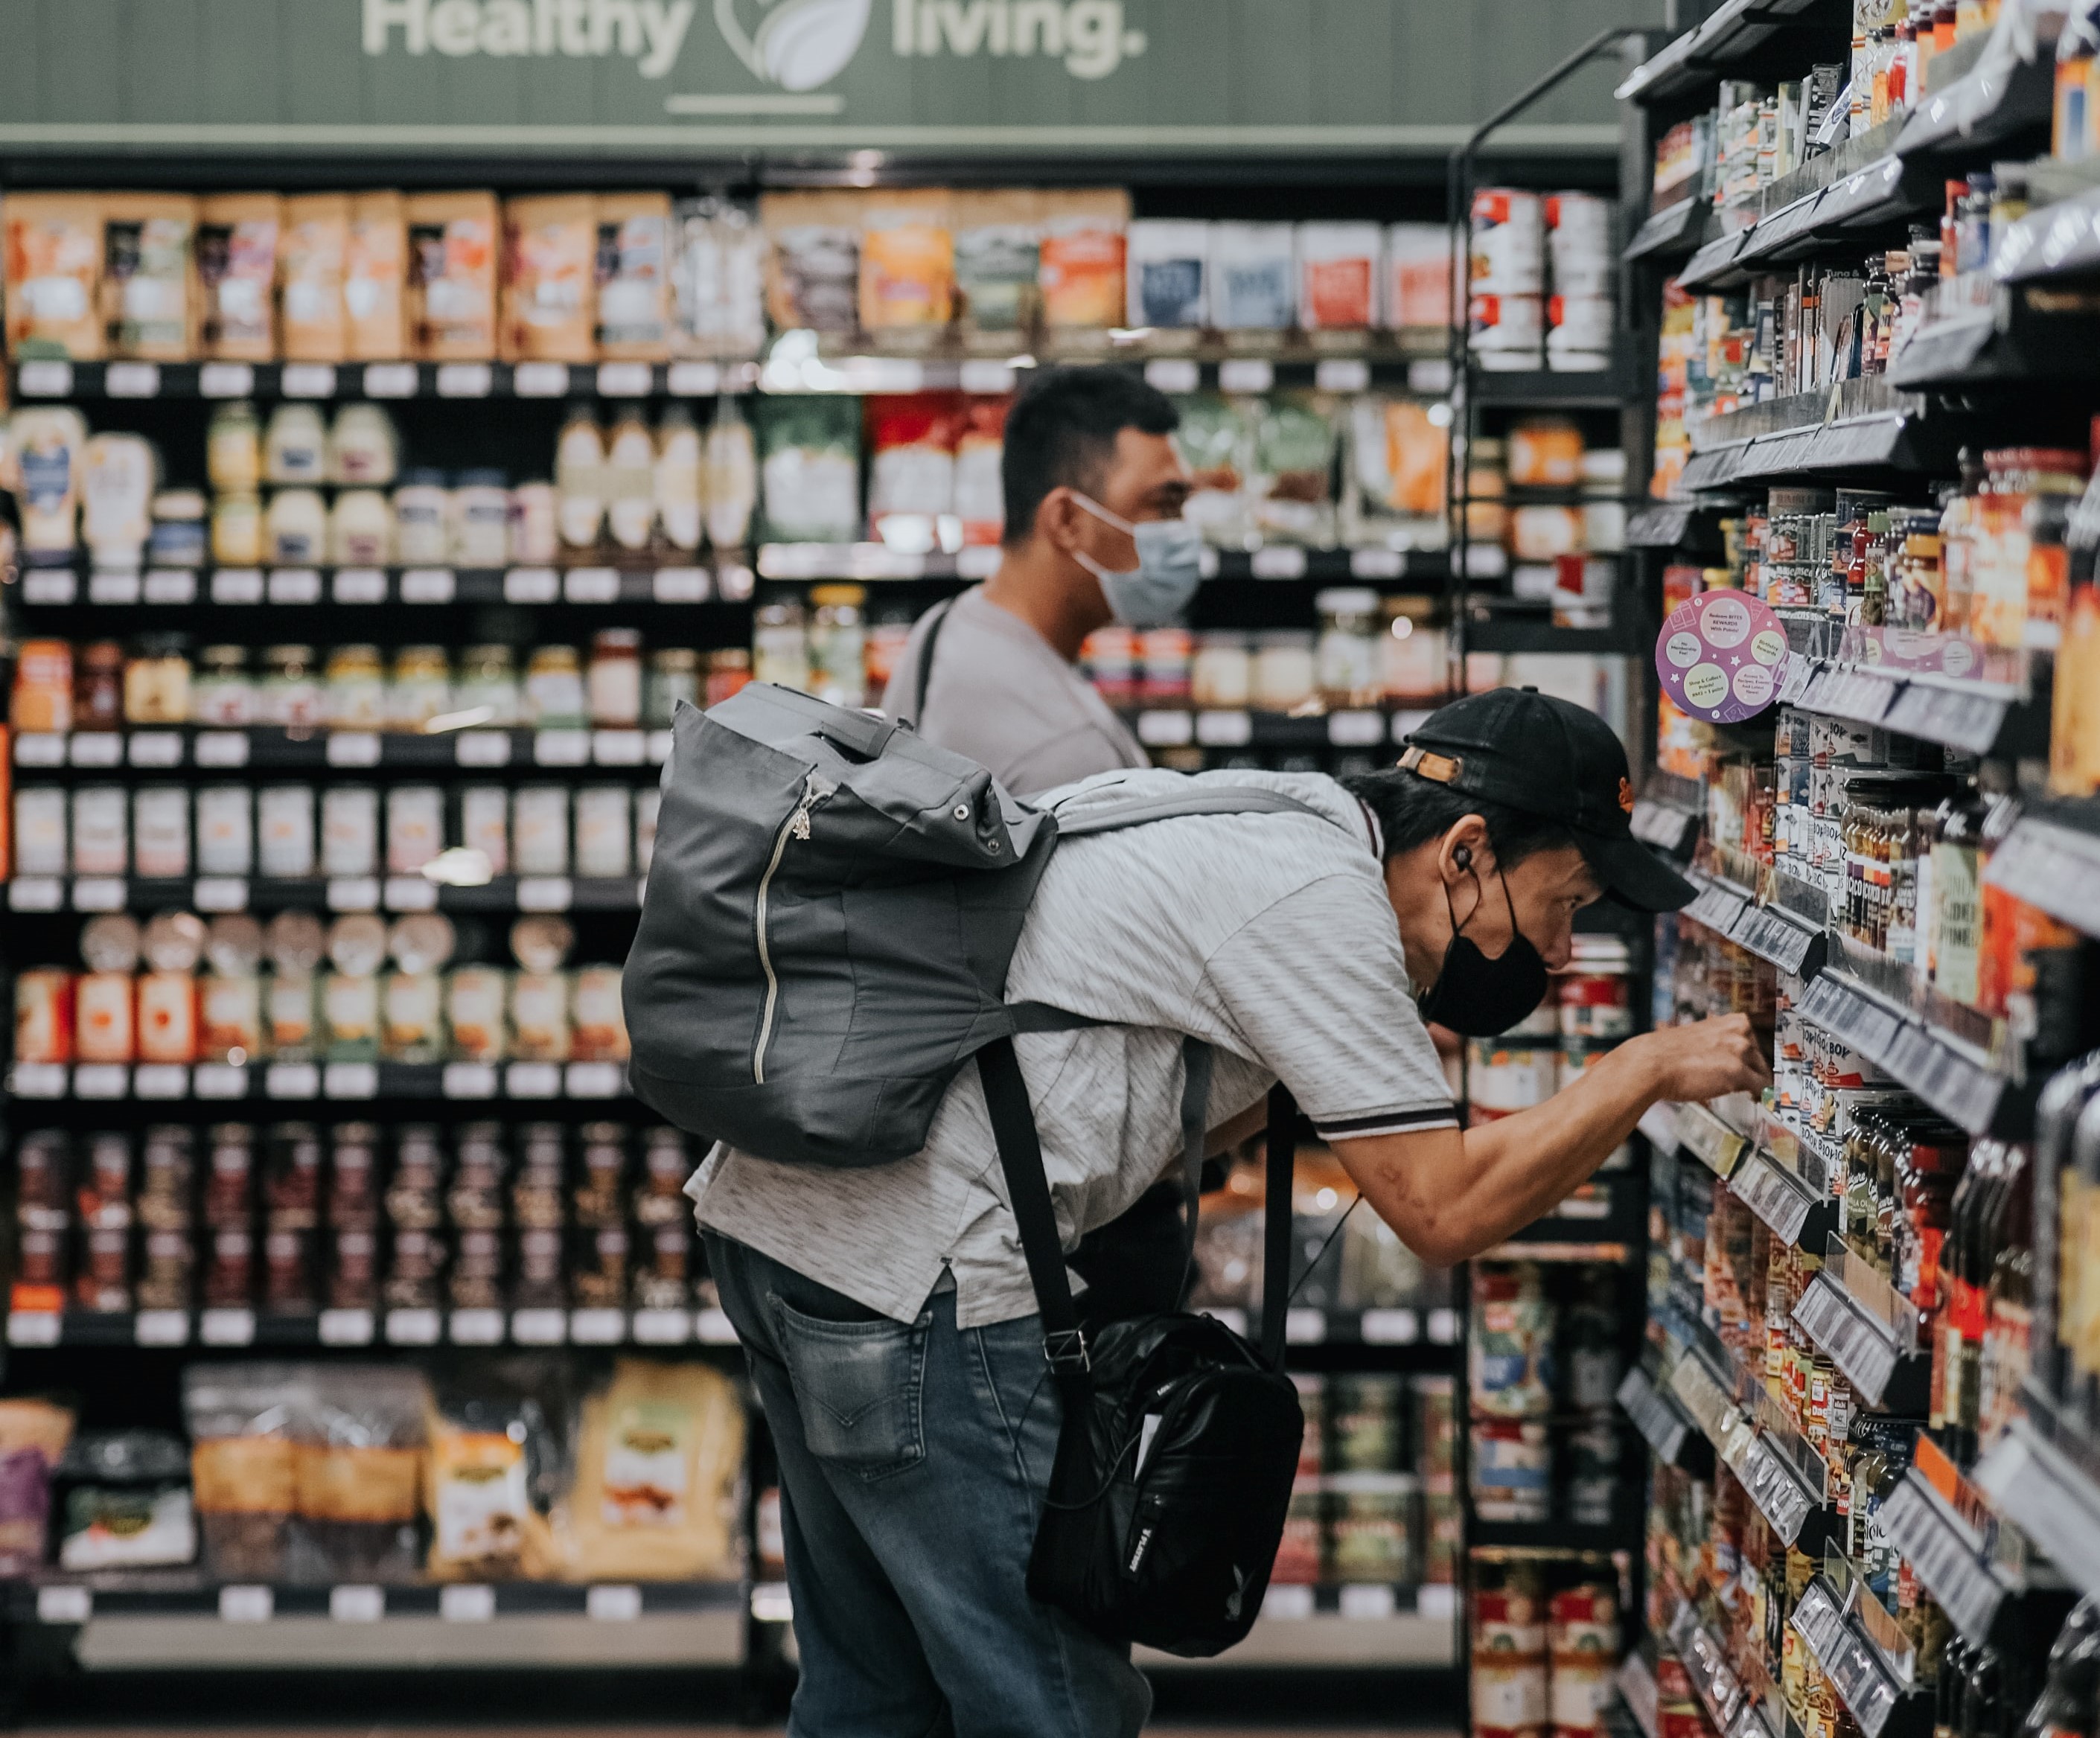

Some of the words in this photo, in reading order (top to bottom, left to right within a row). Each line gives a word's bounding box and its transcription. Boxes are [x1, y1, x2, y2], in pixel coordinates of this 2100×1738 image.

[360, 0, 695, 78] Healthy
[891, 0, 1147, 79] living.
[1829, 1041, 1852, 1060] BOY
